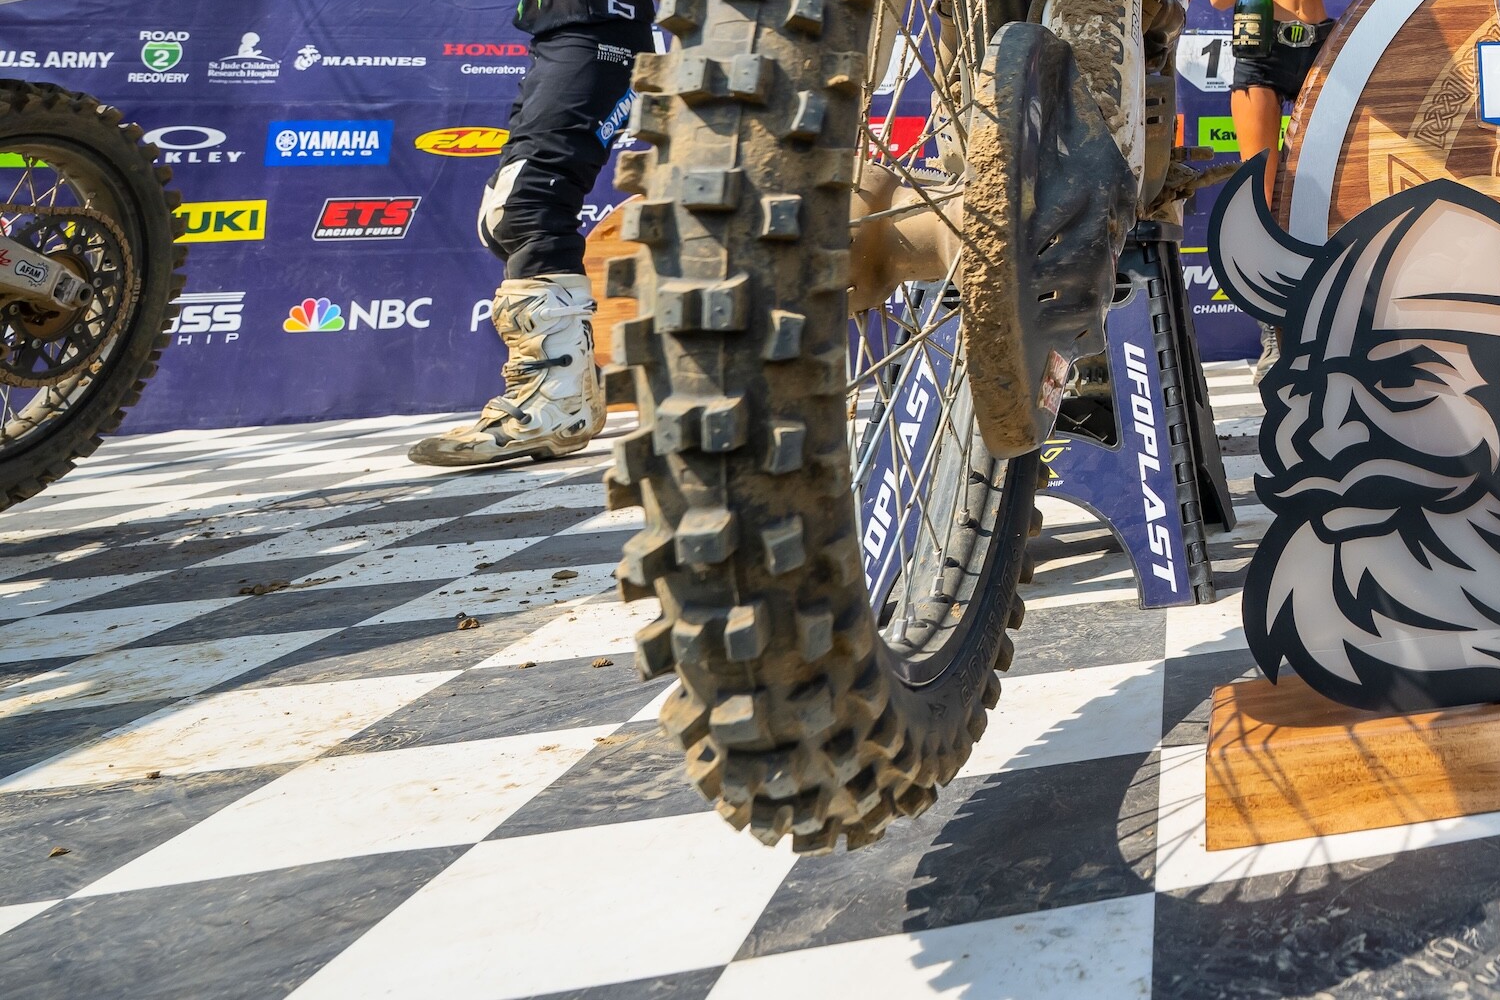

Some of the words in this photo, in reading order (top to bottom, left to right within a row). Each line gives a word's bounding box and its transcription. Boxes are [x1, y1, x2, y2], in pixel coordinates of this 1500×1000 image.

[139, 31, 190, 41] ROAD
[442, 43, 529, 56] HOND
[44, 52, 114, 68] ARMY
[153, 49, 169, 66] 2
[322, 56, 427, 67] MARINES
[1201, 38, 1223, 79] 1
[208, 61, 220, 70] St.
[220, 62, 241, 71] Jude
[461, 63, 526, 76] Generators
[128, 73, 190, 83] RECOVERY
[208, 69, 246, 77] Research
[246, 69, 280, 79] Hospital
[298, 130, 379, 149] YAMAHA
[153, 151, 243, 163] KLEY
[325, 200, 415, 224] ETS
[316, 228, 364, 237] RACING
[365, 226, 402, 236] FUELS
[19, 263, 42, 280] AFAM
[350, 298, 433, 329] NBC
[1123, 341, 1178, 593] UFOPLAST
